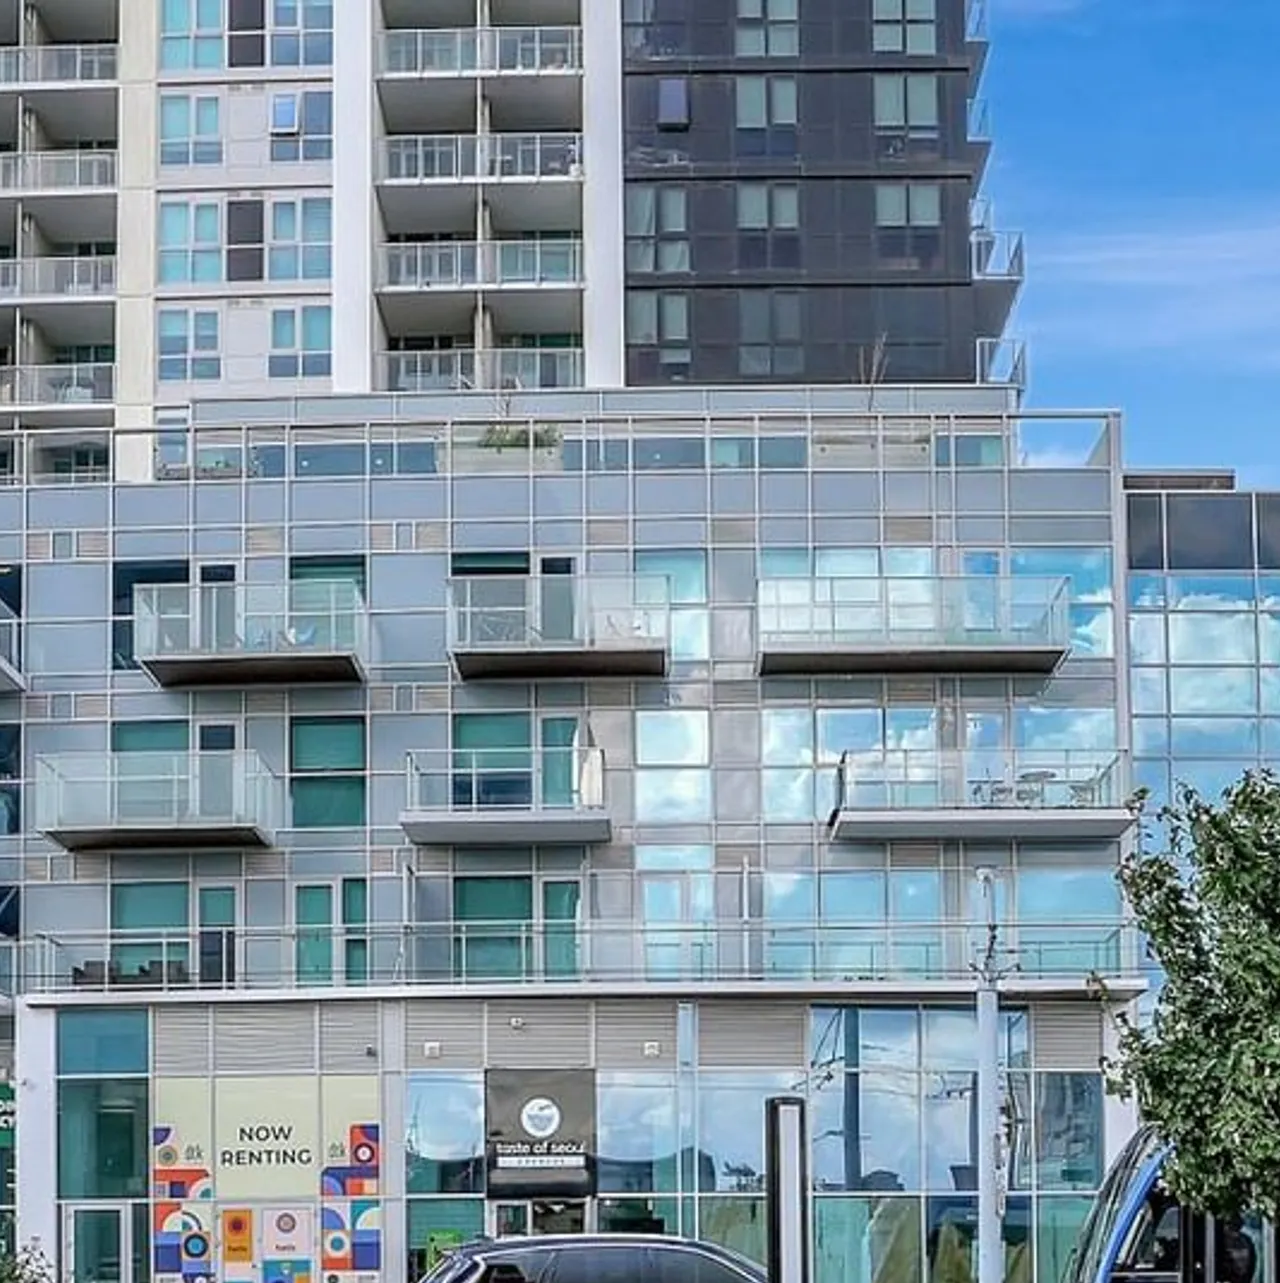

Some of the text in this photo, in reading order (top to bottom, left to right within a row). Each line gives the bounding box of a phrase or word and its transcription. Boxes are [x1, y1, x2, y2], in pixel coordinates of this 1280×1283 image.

[238, 1126, 293, 1142] NOW
[496, 1140, 585, 1154] taste of seoul
[220, 1149, 313, 1166] RENTING
